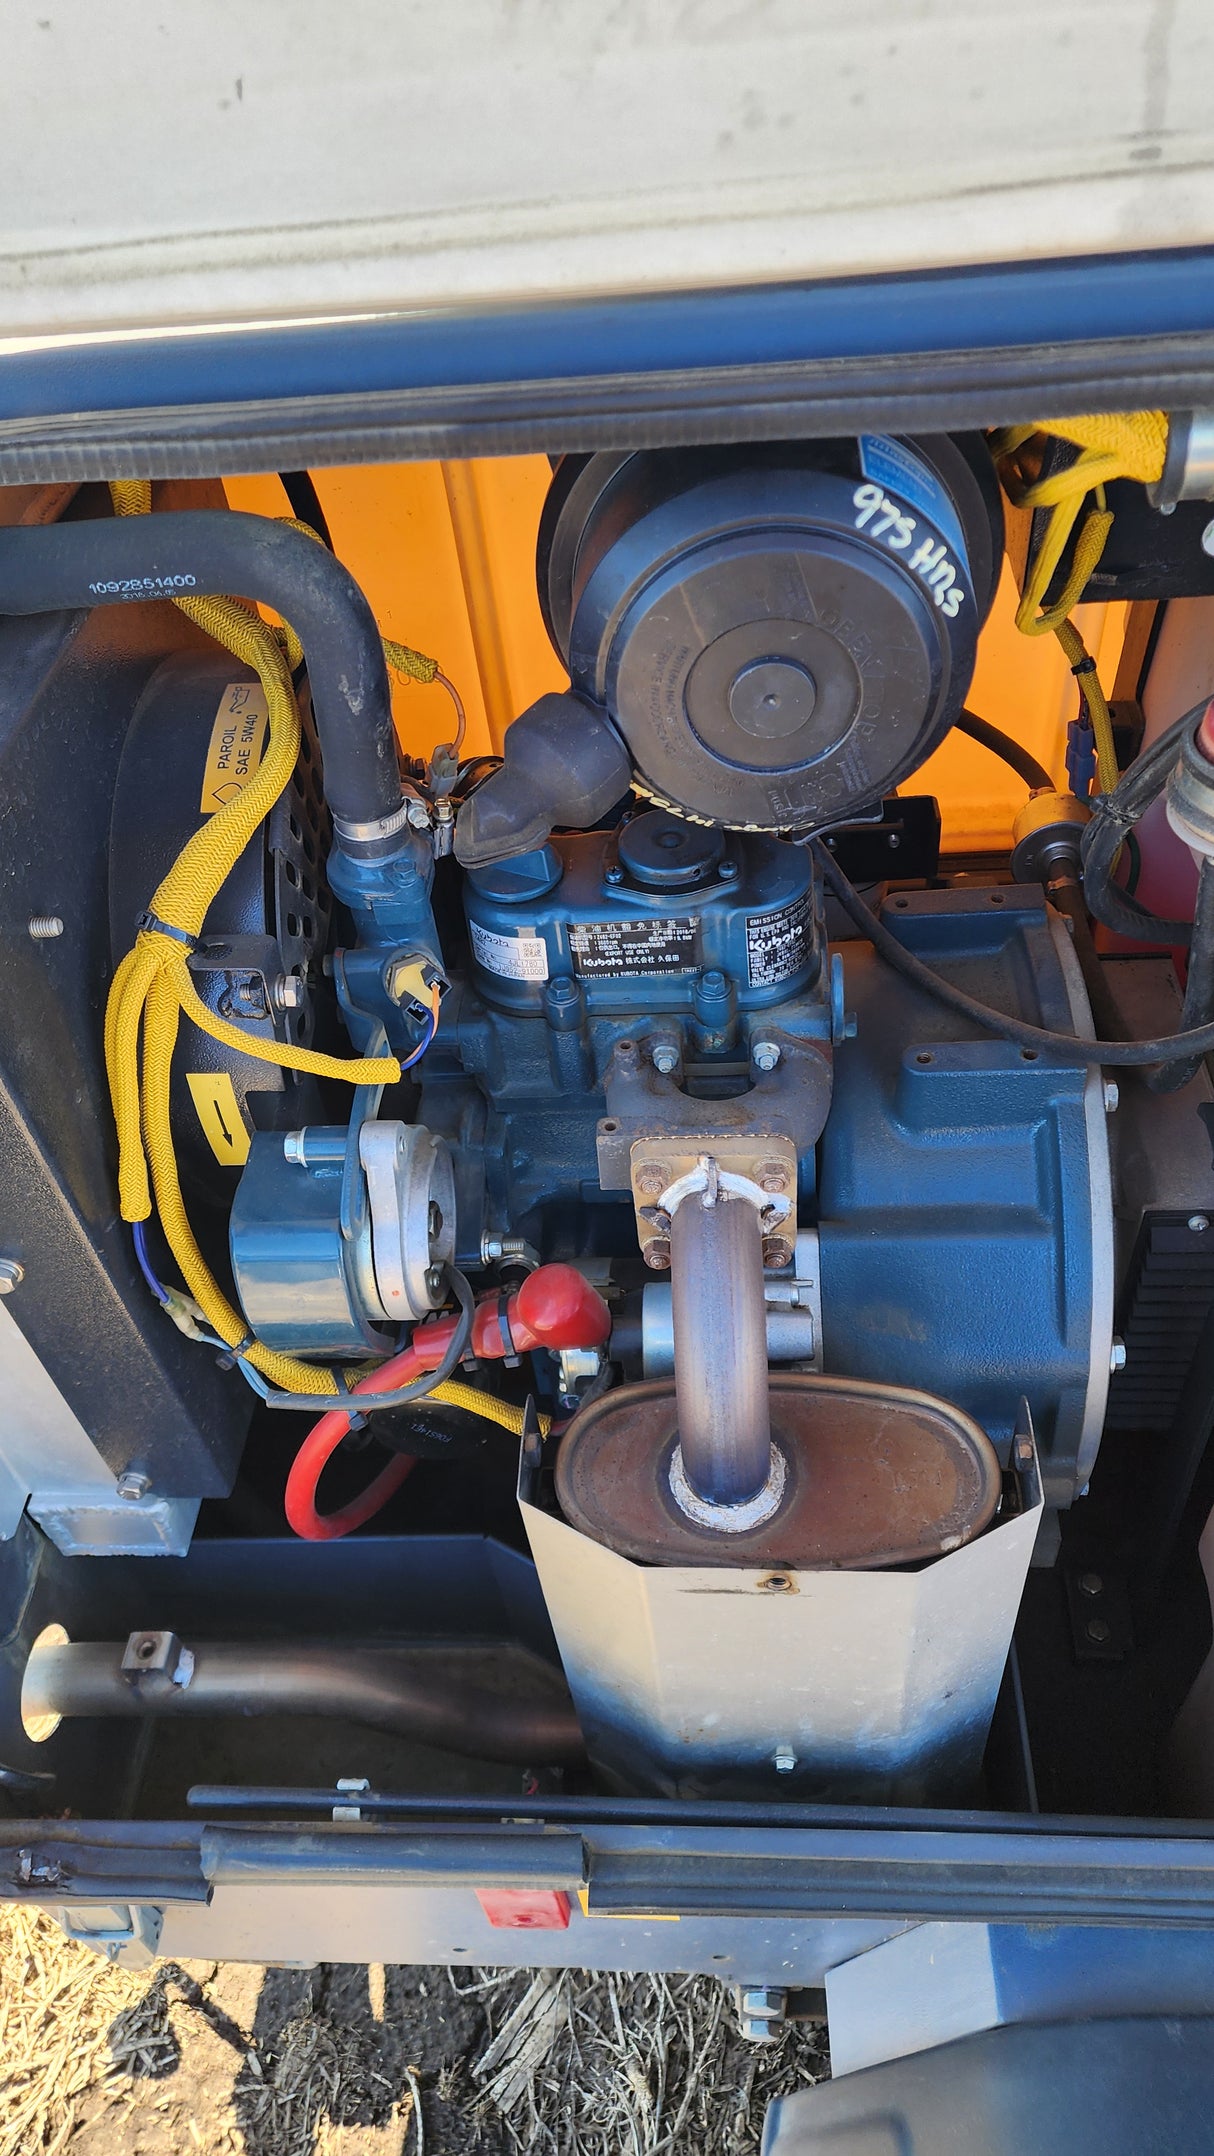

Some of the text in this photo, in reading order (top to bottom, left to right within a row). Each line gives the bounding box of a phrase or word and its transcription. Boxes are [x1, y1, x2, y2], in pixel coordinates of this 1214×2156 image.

[89, 574, 196, 594] 1092851400
[218, 725, 237, 769] PAROIL
[235, 714, 258, 775] SAE 5W40
[750, 912, 783, 926] EMISSION
[750, 925, 803, 952] Kubota
[583, 954, 680, 967] Kubota 株式会社 久保田
